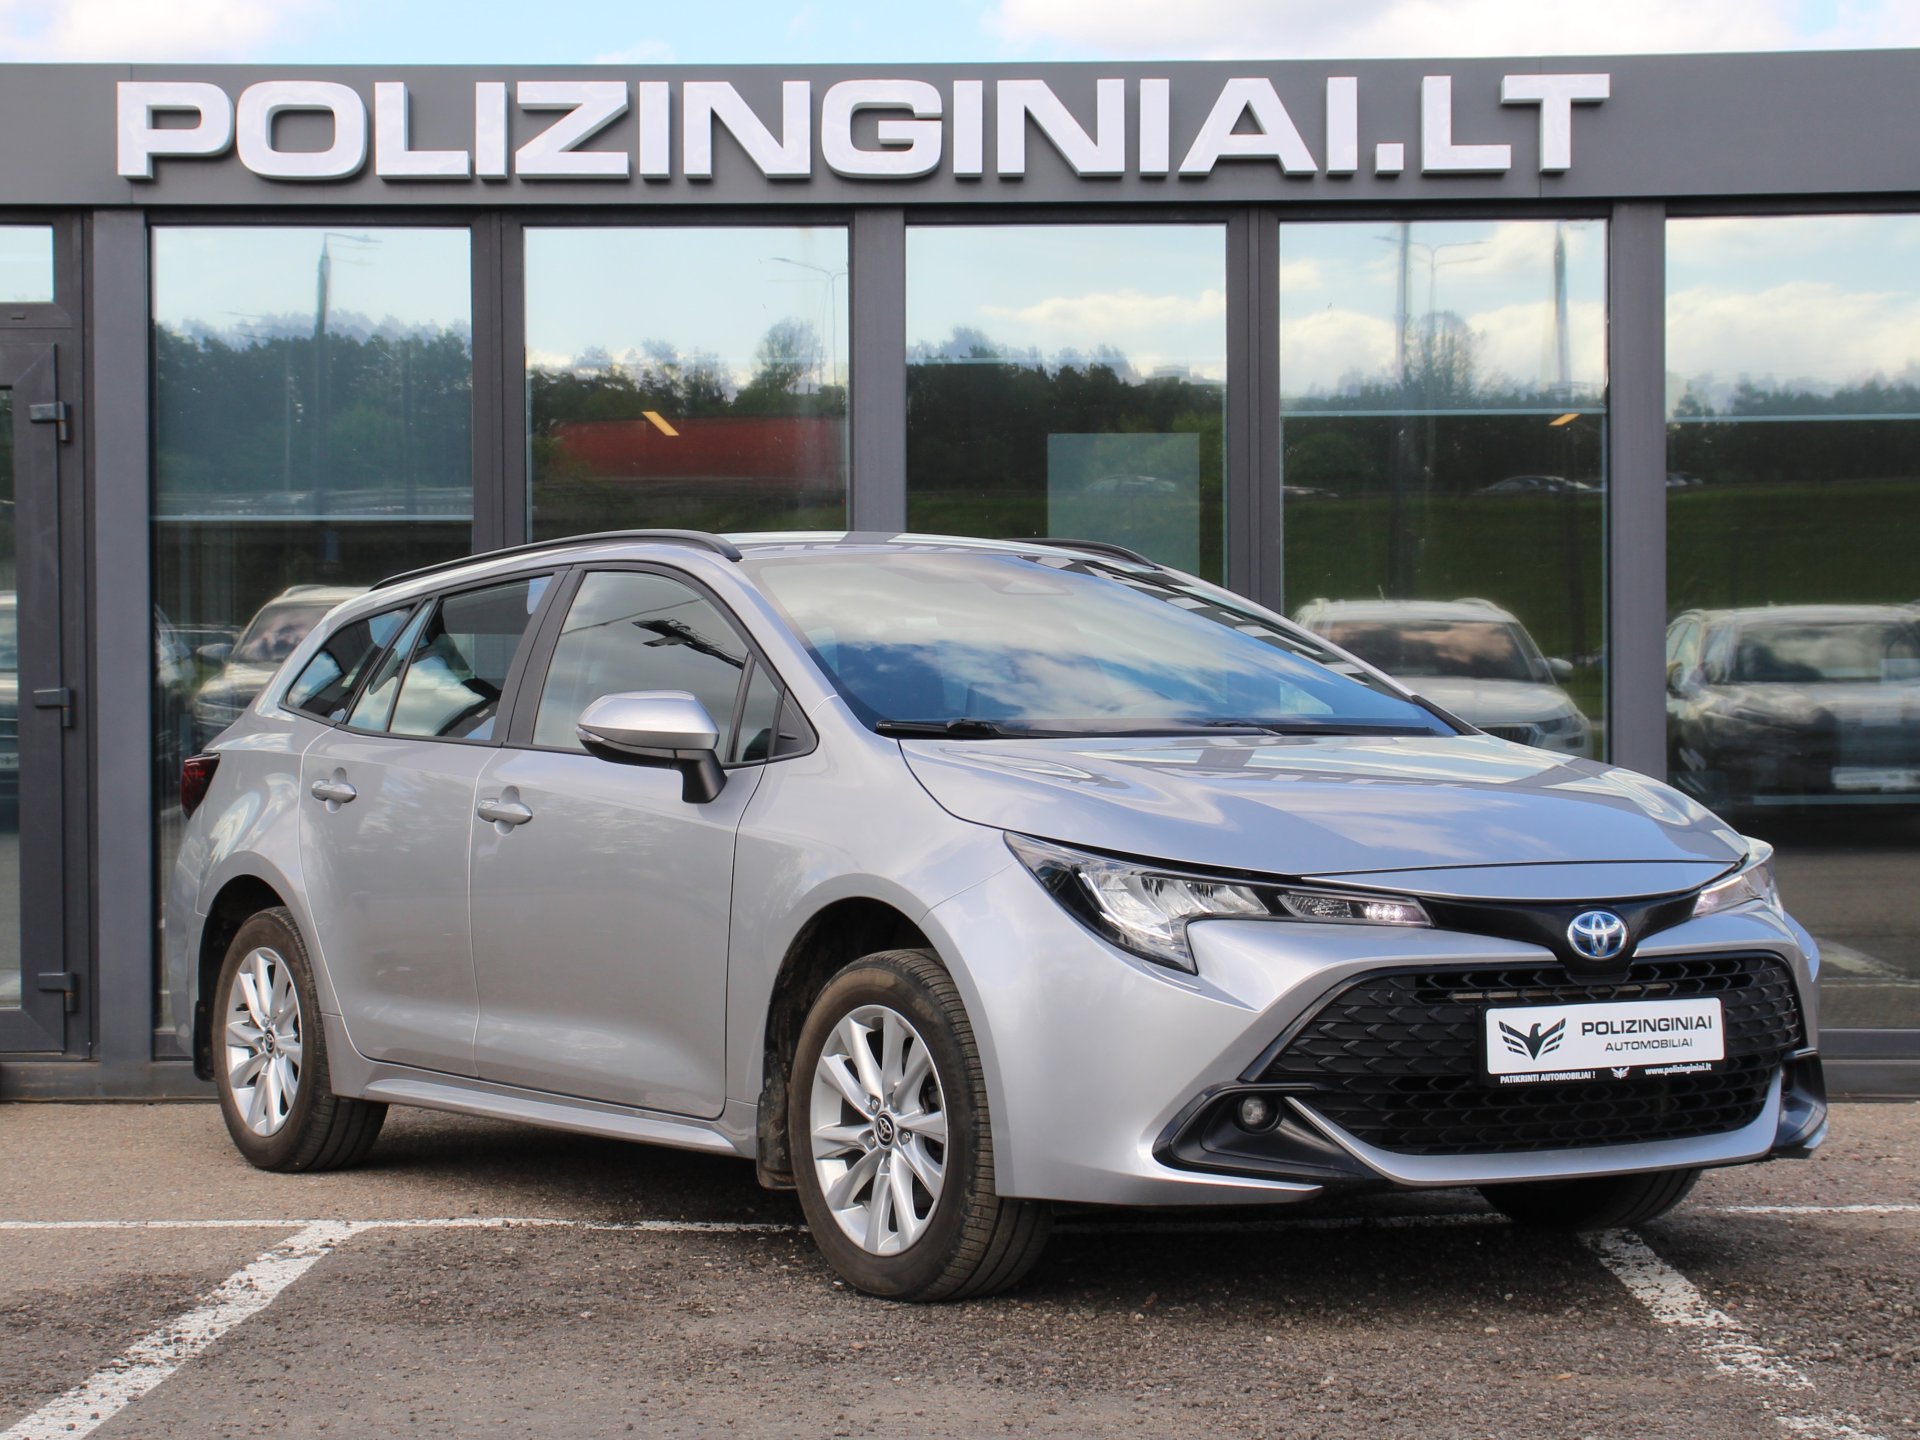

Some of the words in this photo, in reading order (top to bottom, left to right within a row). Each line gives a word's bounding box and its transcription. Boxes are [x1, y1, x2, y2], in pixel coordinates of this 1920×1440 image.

[116, 73, 1610, 181] POLIZINGINIAI.LT
[1581, 1015, 1712, 1036] POLIZINGINIAI
[1605, 1037, 1693, 1052] AUTOMOBILIAI
[1644, 1062, 1712, 1076] www.polizinginiai.lt
[1500, 1073, 1539, 1084] PATIKRINTI
[1540, 1071, 1592, 1081] AUTOMOBILIAI
